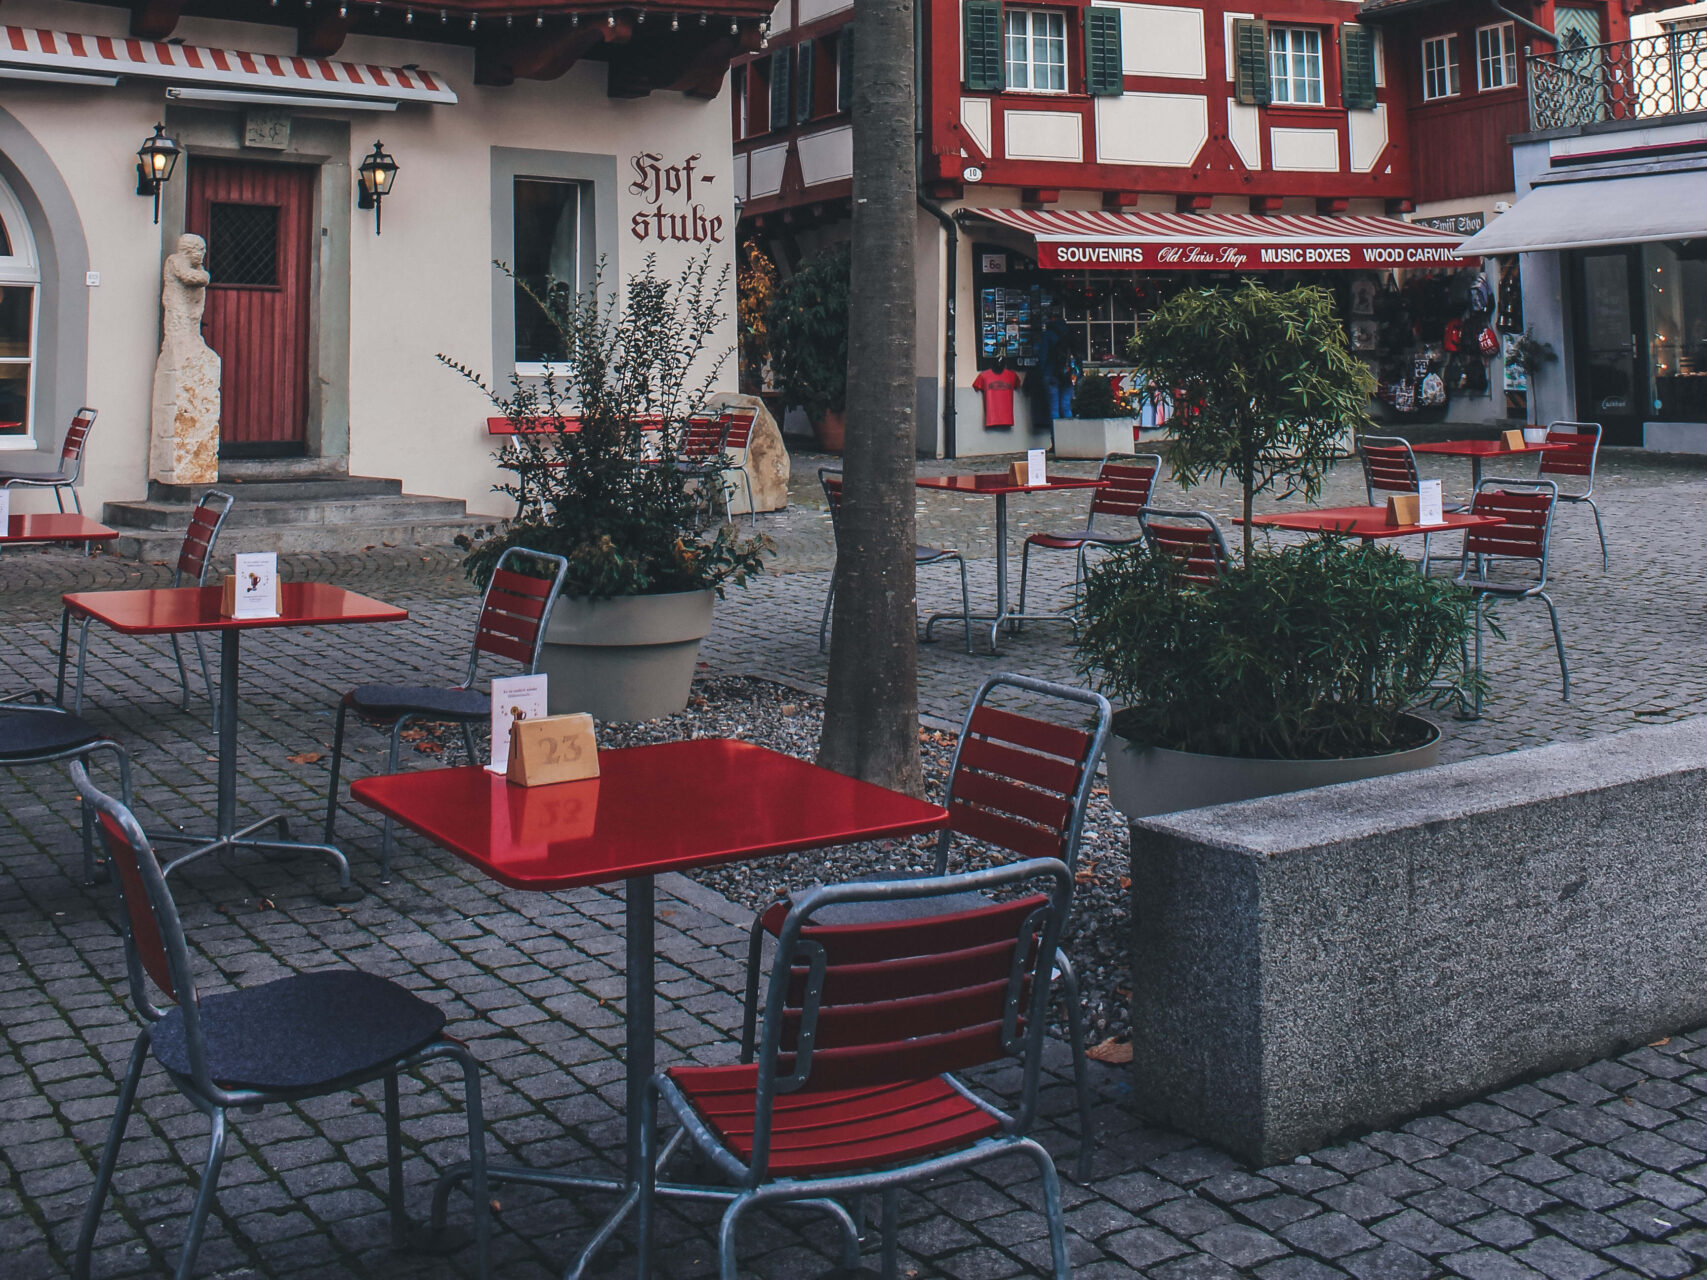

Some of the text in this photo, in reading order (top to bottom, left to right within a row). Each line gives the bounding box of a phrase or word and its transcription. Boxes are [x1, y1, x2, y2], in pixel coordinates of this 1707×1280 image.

[628, 151, 716, 205] Hof-
[969, 168, 978, 177] 10
[631, 203, 725, 244] stube
[1457, 215, 1482, 232] Shop
[1057, 246, 1463, 267] SOUVENIRS Old Swiss Shop MUSIC BOXES WOOD CARVIN
[538, 734, 582, 765] 23
